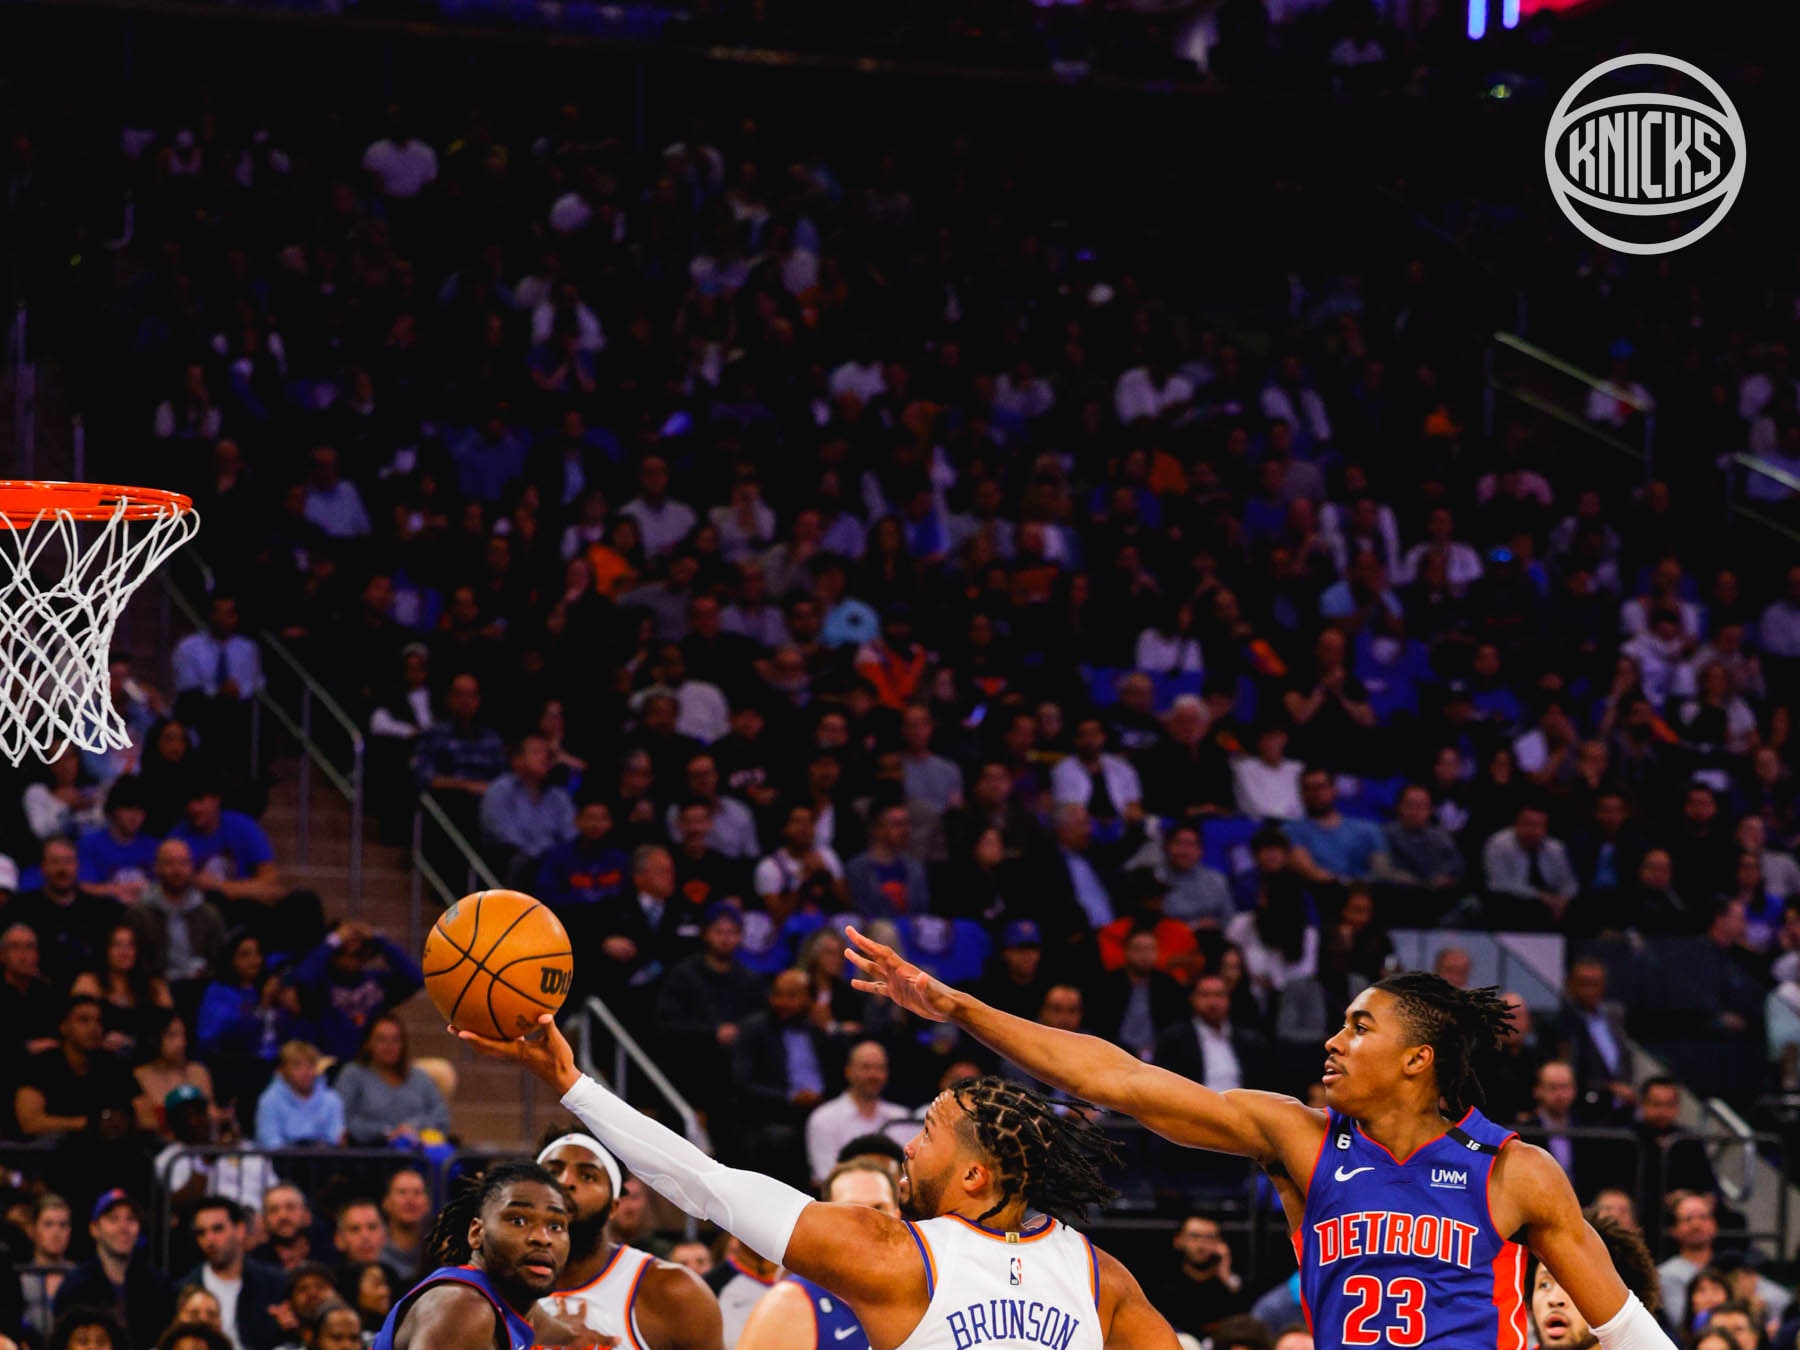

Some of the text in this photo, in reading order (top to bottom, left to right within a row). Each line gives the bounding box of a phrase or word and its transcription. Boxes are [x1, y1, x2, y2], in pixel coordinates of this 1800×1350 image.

[1336, 1133, 1351, 1149] 6
[1431, 1168, 1467, 1185] UWM
[1313, 1210, 1479, 1269] DETROIT
[1342, 1274, 1426, 1348] 23
